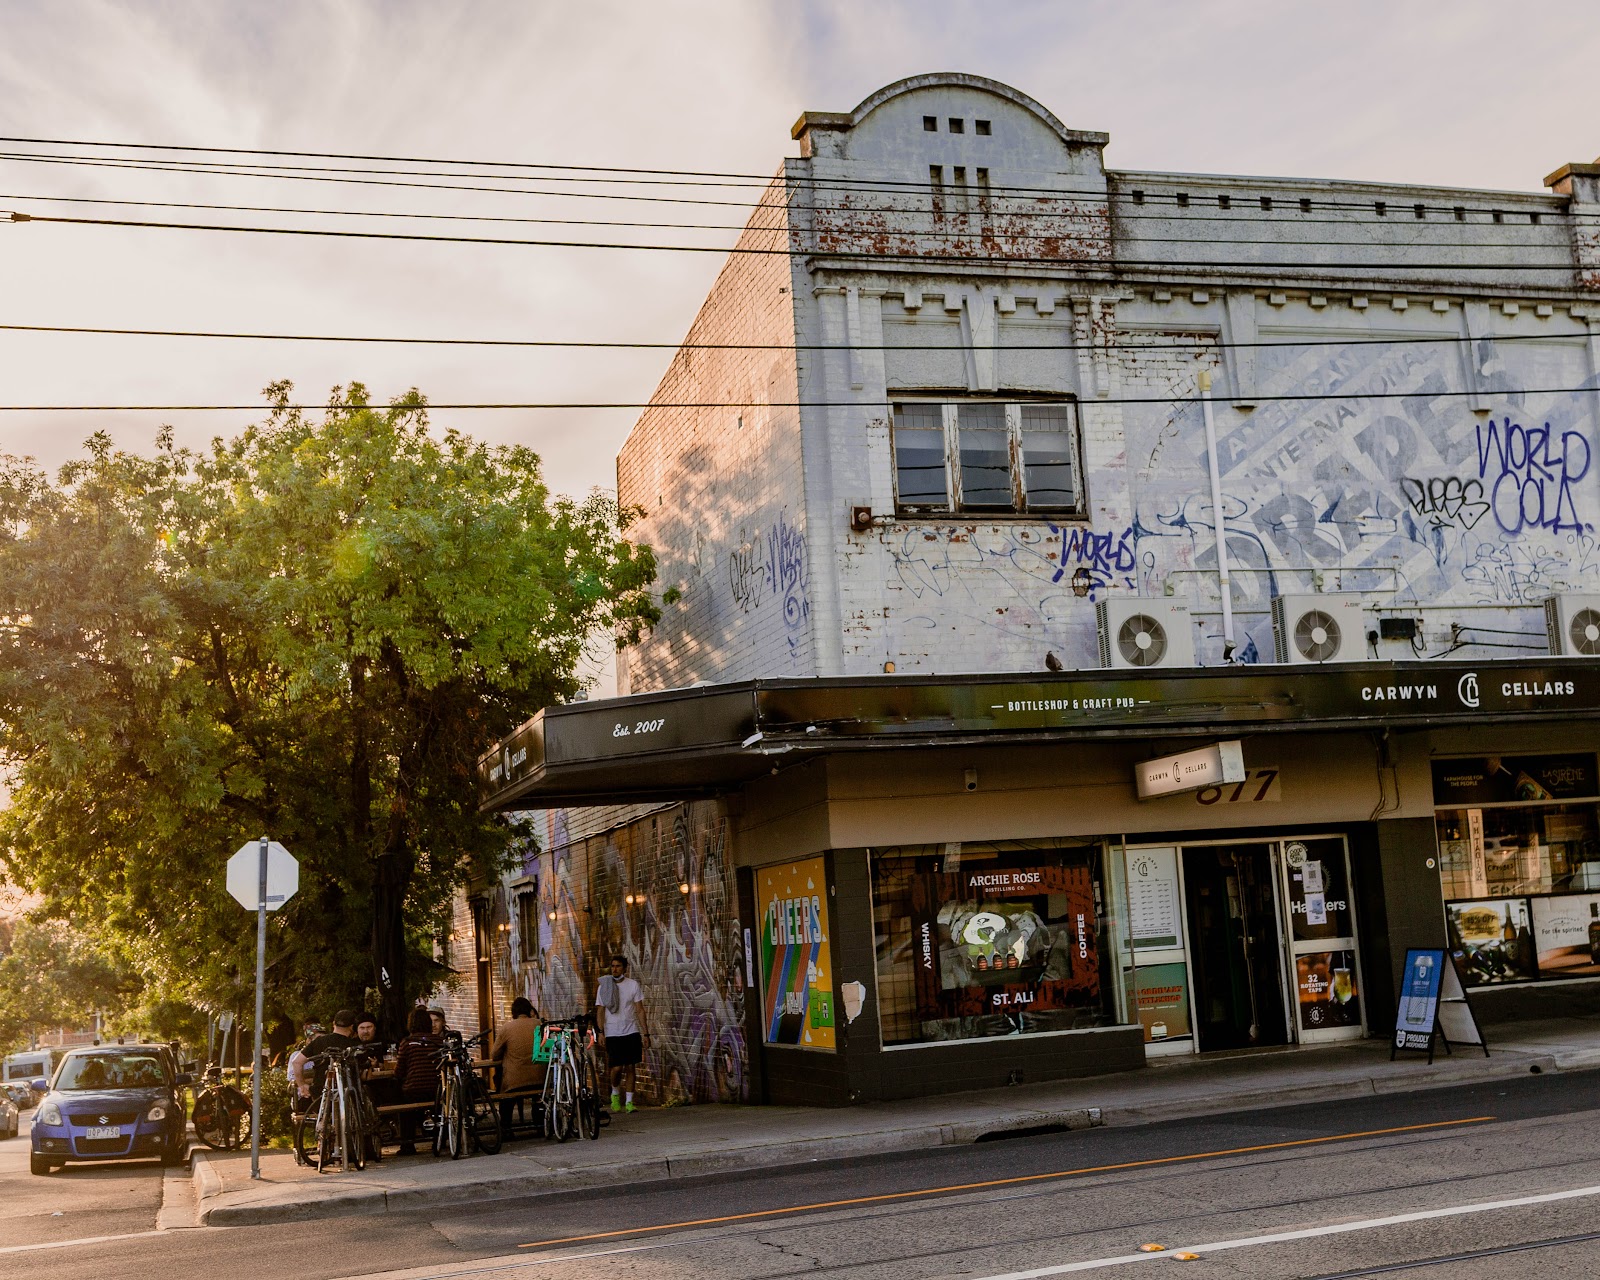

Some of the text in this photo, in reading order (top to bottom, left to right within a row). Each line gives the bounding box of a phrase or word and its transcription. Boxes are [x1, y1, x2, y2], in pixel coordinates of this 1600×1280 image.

[1475, 416, 1591, 484] WORLD
[1361, 681, 1575, 700] CARWYN CELLARS
[1008, 697, 1135, 712] BOTTLESHOP & CRAFT PUB
[612, 719, 665, 738] Est. 2007
[1149, 763, 1207, 782] CARWYN CELLARS
[969, 873, 1040, 886] ARCHIE ROSE
[1291, 900, 1346, 914] Haers
[769, 895, 822, 946] CHEERS
[1076, 913, 1088, 959] COFFEE
[921, 922, 932, 969] WHISKY
[1300, 981, 1329, 989] ROTATING
[1308, 974, 1318, 983] 32
[992, 994, 1011, 1006] ST.
[1406, 1033, 1430, 1043] PROUDLY
[106, 1127, 119, 1136] 750
